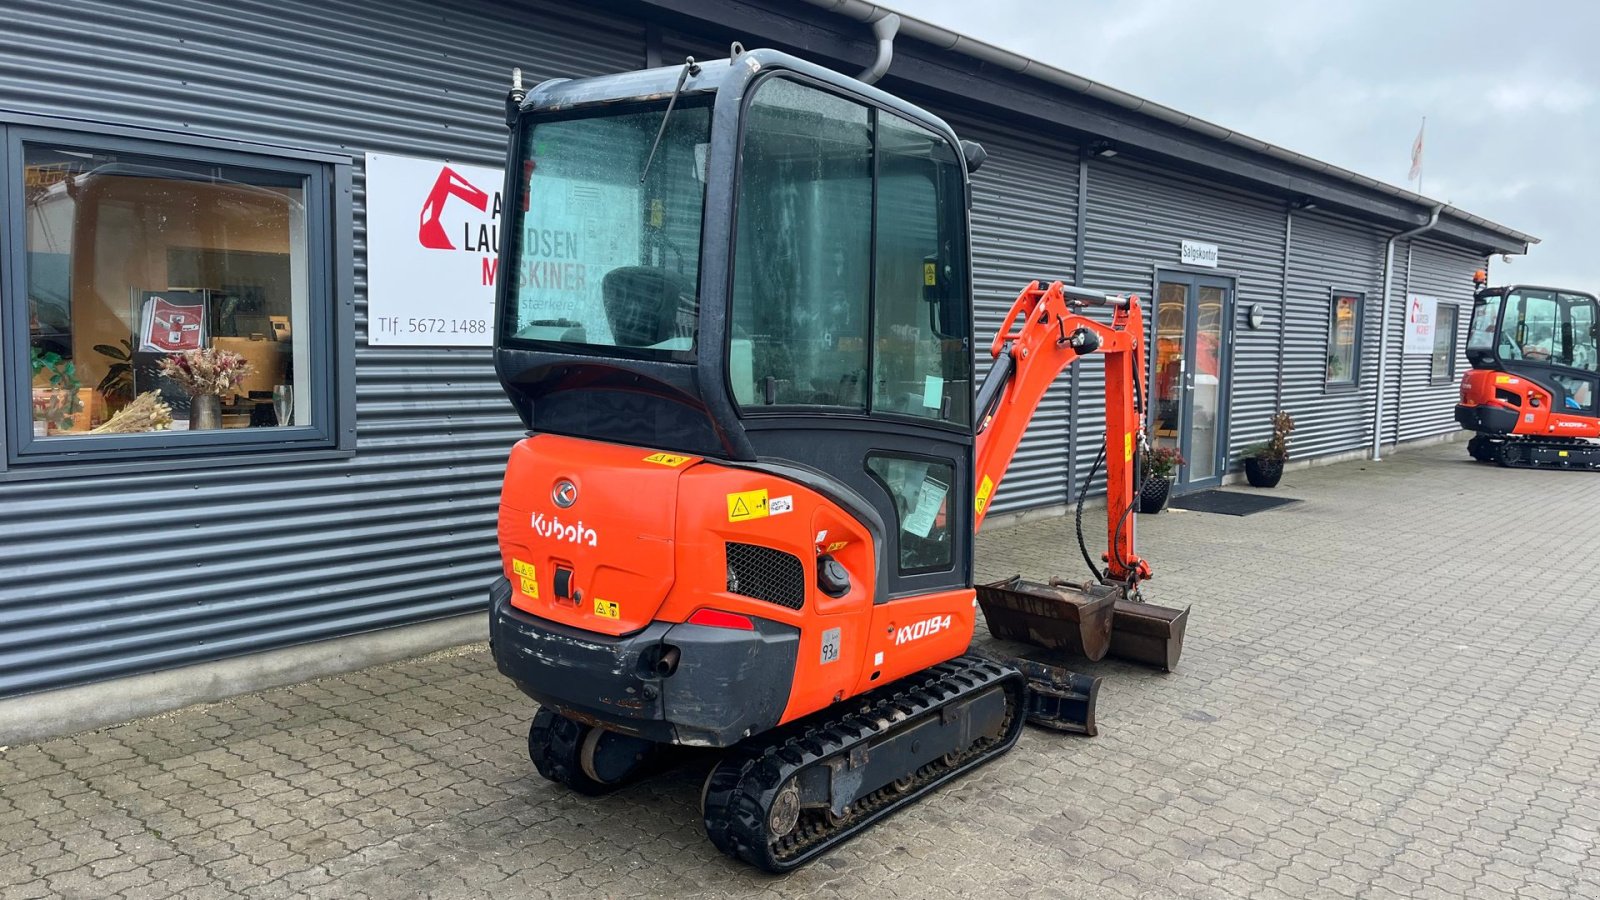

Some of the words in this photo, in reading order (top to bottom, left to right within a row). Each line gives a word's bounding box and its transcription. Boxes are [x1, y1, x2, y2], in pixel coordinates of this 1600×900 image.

[1183, 244, 1217, 261] Salgskontor
[482, 257, 586, 291] MSKINER
[378, 317, 403, 336] Tlf.
[408, 318, 446, 333] 5672
[450, 319, 486, 334] 1488
[531, 511, 597, 547] Kubota
[895, 615, 951, 646] KX019-4
[822, 643, 834, 661] 93
